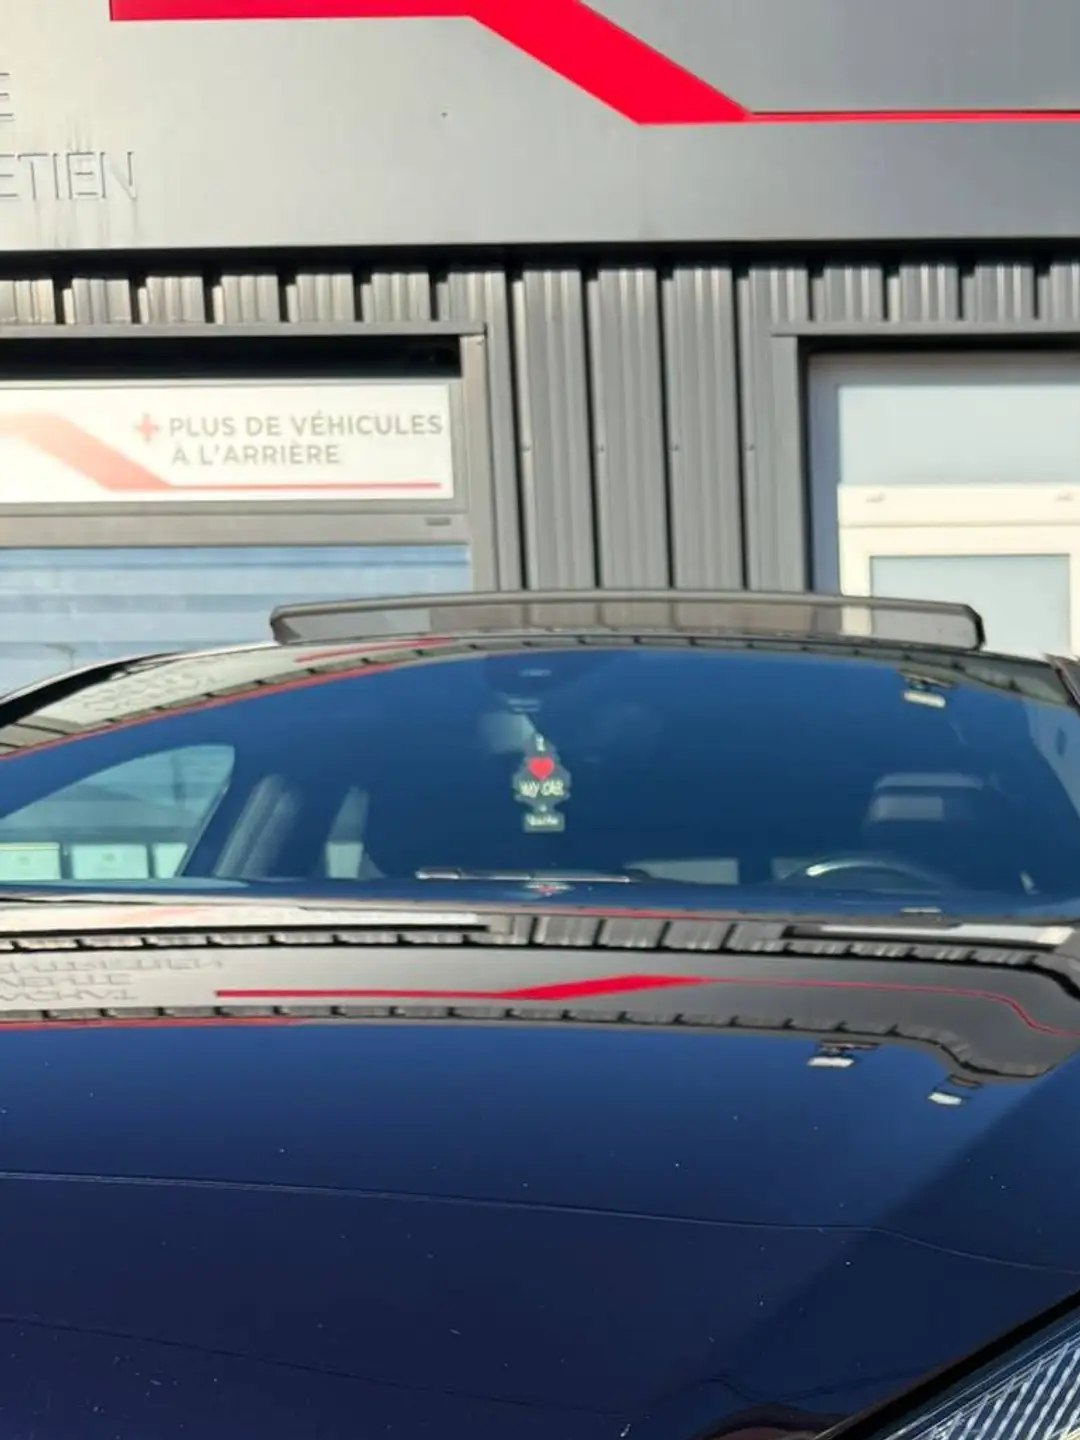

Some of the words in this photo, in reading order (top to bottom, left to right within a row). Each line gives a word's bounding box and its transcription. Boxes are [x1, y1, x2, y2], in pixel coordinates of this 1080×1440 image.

[169, 416, 236, 437] PLUS
[245, 415, 282, 436] DE
[289, 409, 443, 436] VÉHICULES
[199, 440, 341, 465] L'ARRIÈRE
